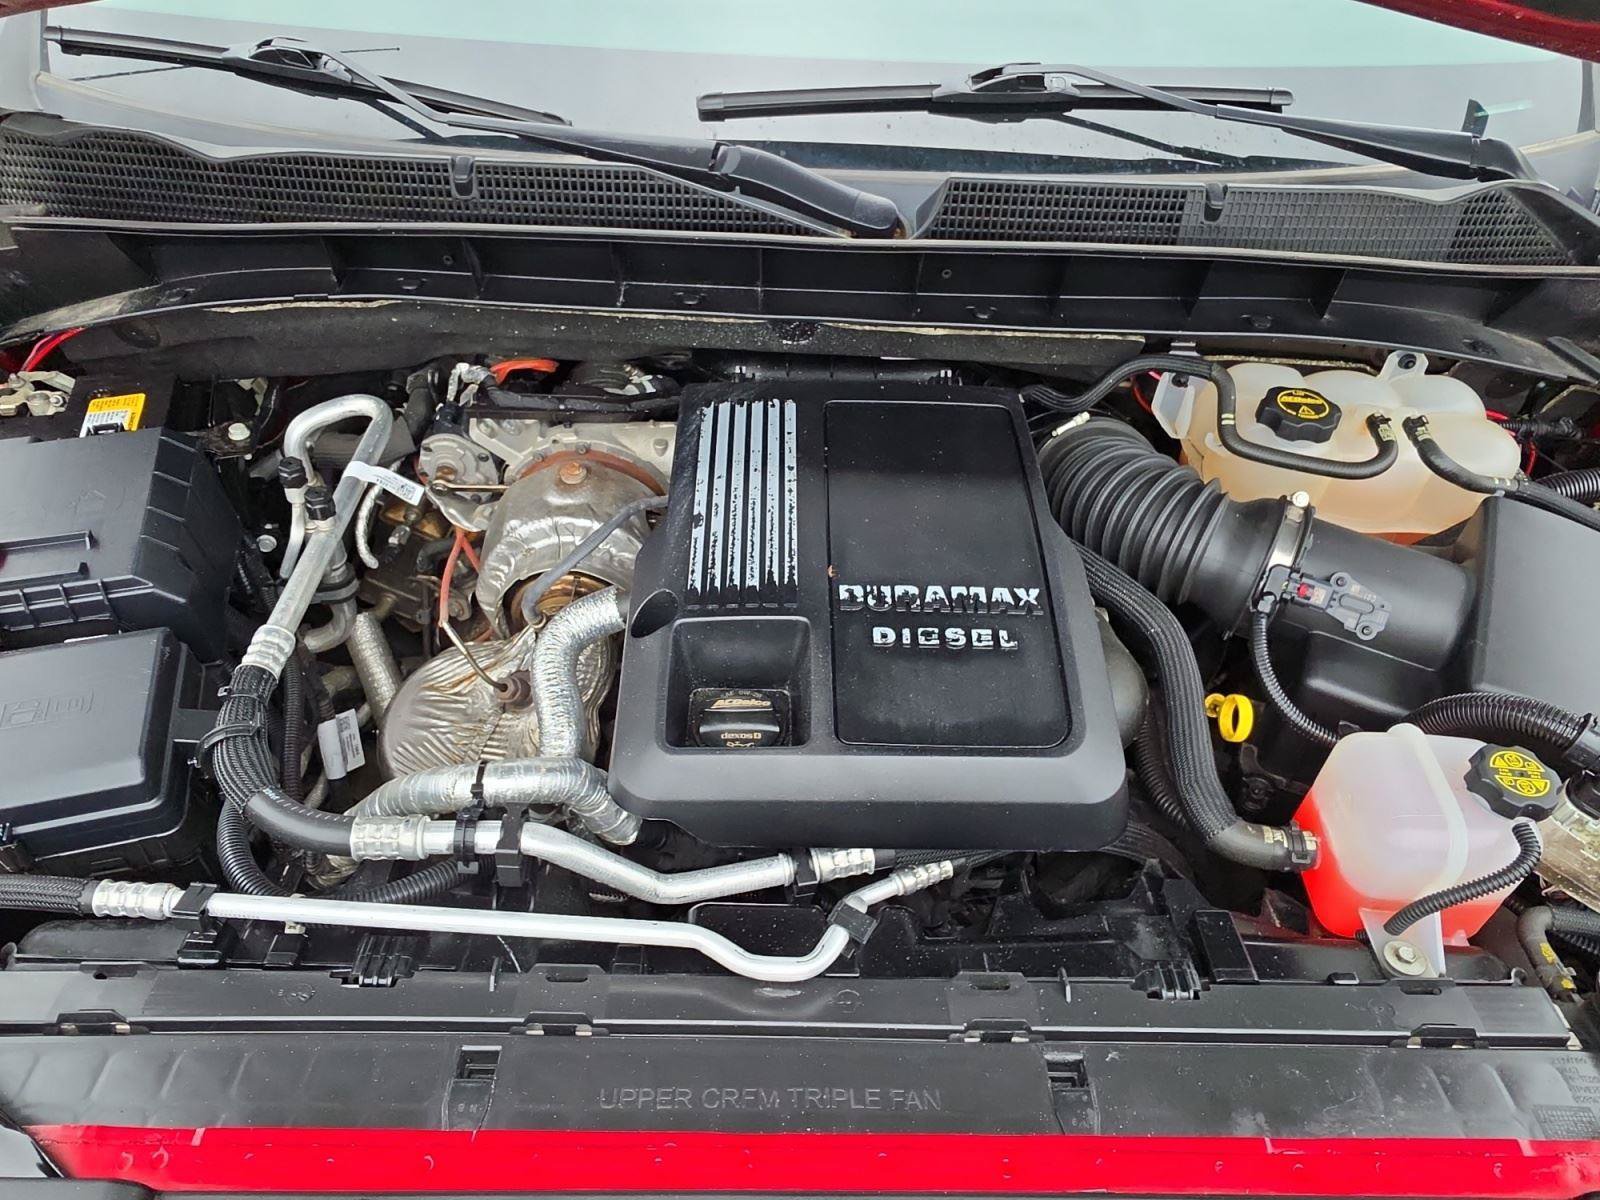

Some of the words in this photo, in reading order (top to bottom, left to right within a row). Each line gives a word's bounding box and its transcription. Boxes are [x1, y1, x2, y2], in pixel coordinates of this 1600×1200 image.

[838, 584, 1044, 615] DURAMAX
[871, 626, 1019, 650] DIESEL
[599, 1087, 693, 1110] UPPER
[787, 1087, 881, 1110] TRIPLE
[889, 1088, 942, 1111] FAN
